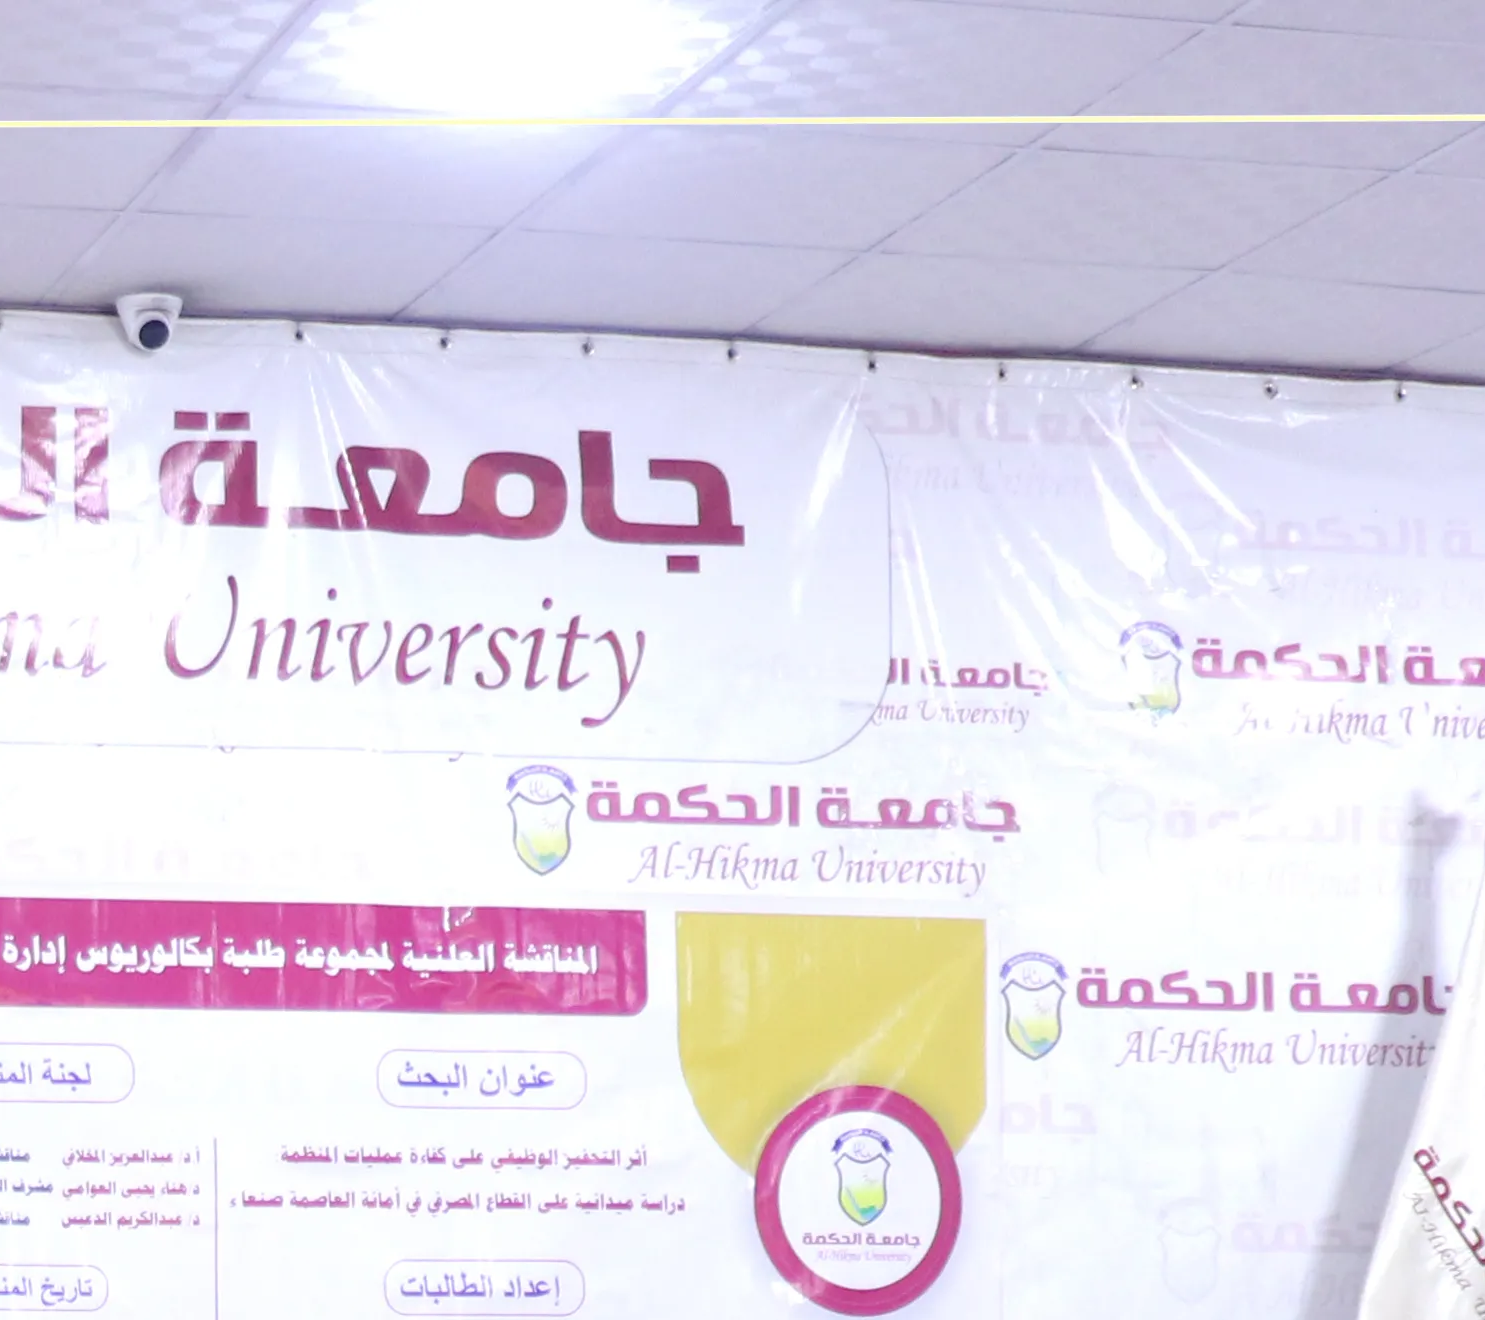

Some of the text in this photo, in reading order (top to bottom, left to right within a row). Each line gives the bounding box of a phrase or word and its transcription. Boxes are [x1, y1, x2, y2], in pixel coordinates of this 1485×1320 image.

[158, 408, 746, 574] جامعة
[160, 574, 648, 728] University
[585, 781, 1021, 840] جامعة الحكمة
[629, 842, 986, 896] Al-Hikma University
[2, 933, 67, 974] إدارة
[77, 936, 214, 972] بكالوريوس
[222, 938, 286, 972] طلبة
[295, 941, 394, 976] لمجموعة
[402, 943, 494, 975] العلنية
[503, 941, 598, 975] المناقشة
[1076, 969, 1453, 1015] امعة الحكمة
[1116, 1027, 1435, 1074] Al-Hikma Universit
[41, 1059, 92, 1091] لجنة
[398, 1063, 555, 1096] عنوان البحث
[343, 1148, 402, 1168] عمليات
[410, 1146, 446, 1164] كفاءة
[451, 1147, 484, 1170] على
[490, 1148, 559, 1173] الوظيفي
[563, 1149, 620, 1170] التحفيز
[625, 1148, 647, 1171] أثر
[290, 1190, 355, 1208] العاصمة
[361, 1186, 401, 1209] أمانة
[406, 1190, 422, 1217] في
[427, 1191, 479, 1215] المصرفي
[486, 1190, 531, 1212] القطاع
[537, 1191, 569, 1213] على
[575, 1191, 634, 1216] ميدانية
[640, 1192, 686, 1214] دراسة
[803, 1232, 921, 1249] جامعة الحكمة
[40, 1276, 93, 1306] تاريخ
[400, 1272, 561, 1308] إعداد الطالبات
